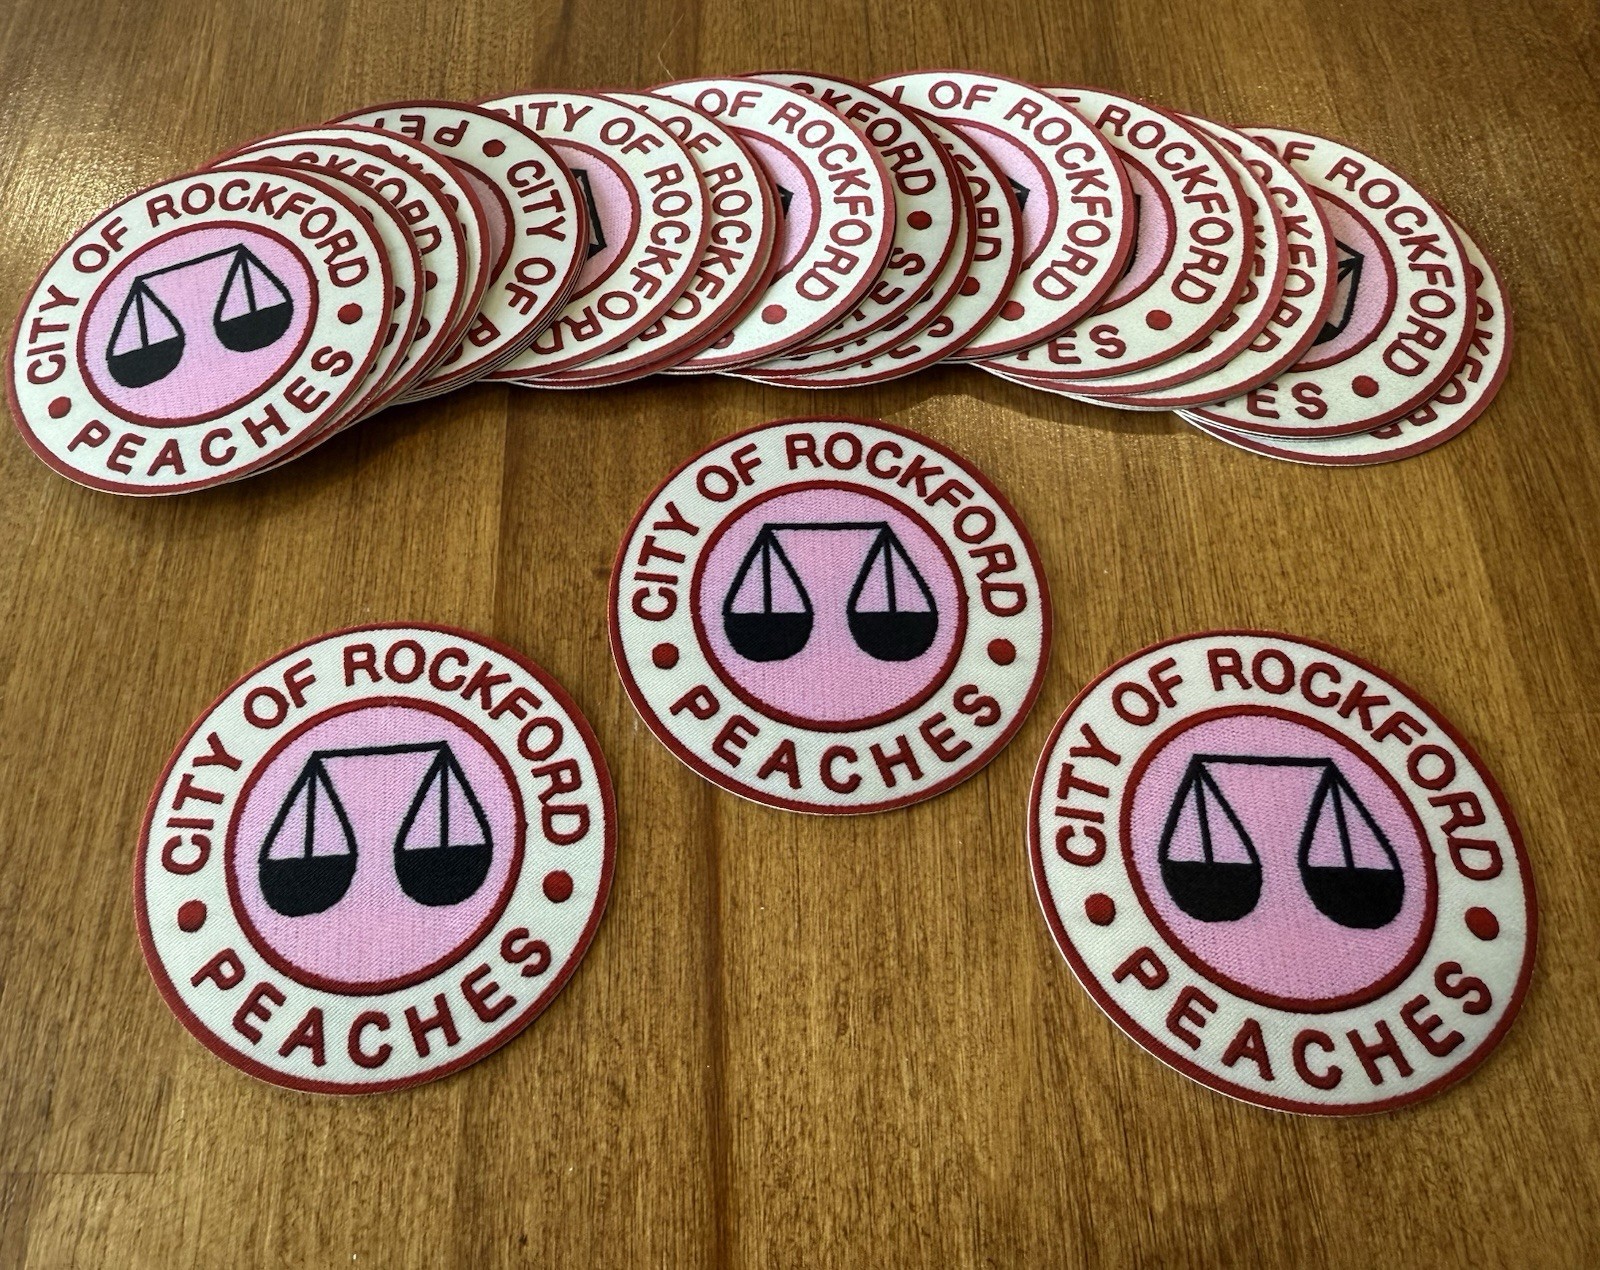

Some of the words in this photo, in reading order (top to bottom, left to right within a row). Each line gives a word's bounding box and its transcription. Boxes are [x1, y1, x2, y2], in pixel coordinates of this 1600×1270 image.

[493, 101, 594, 133] ITY
[507, 160, 566, 242] CITY
[600, 116, 665, 156] OF
[694, 88, 763, 118] OF
[767, 101, 876, 301] ROCKFORD
[927, 80, 998, 111] OF
[1003, 97, 1114, 301] ROCKFORD
[1095, 103, 1235, 304] ROCKFORD
[26, 284, 80, 385] CITY
[72, 216, 130, 273] OF
[146, 178, 369, 288] ROCKFORD
[504, 257, 557, 316] OF
[530, 162, 693, 355] ROCKFORD
[609, 162, 753, 354] ROCKFOR
[1324, 156, 1457, 377] ROCKFORD
[67, 345, 354, 476] PEACHES
[631, 501, 700, 622] CITY
[696, 443, 762, 502] OF
[785, 431, 1028, 618] ROCKFORD
[161, 731, 242, 875] CITY
[243, 658, 317, 730] OF
[343, 639, 591, 846] ROCKFORD
[669, 684, 1002, 794] PEACHES
[1055, 722, 1121, 867] CITY
[1111, 657, 1183, 727] OF
[1207, 647, 1504, 881] ROCKFORD
[190, 926, 553, 1069] PEACHES
[1112, 961, 1493, 1091] PEACHES
